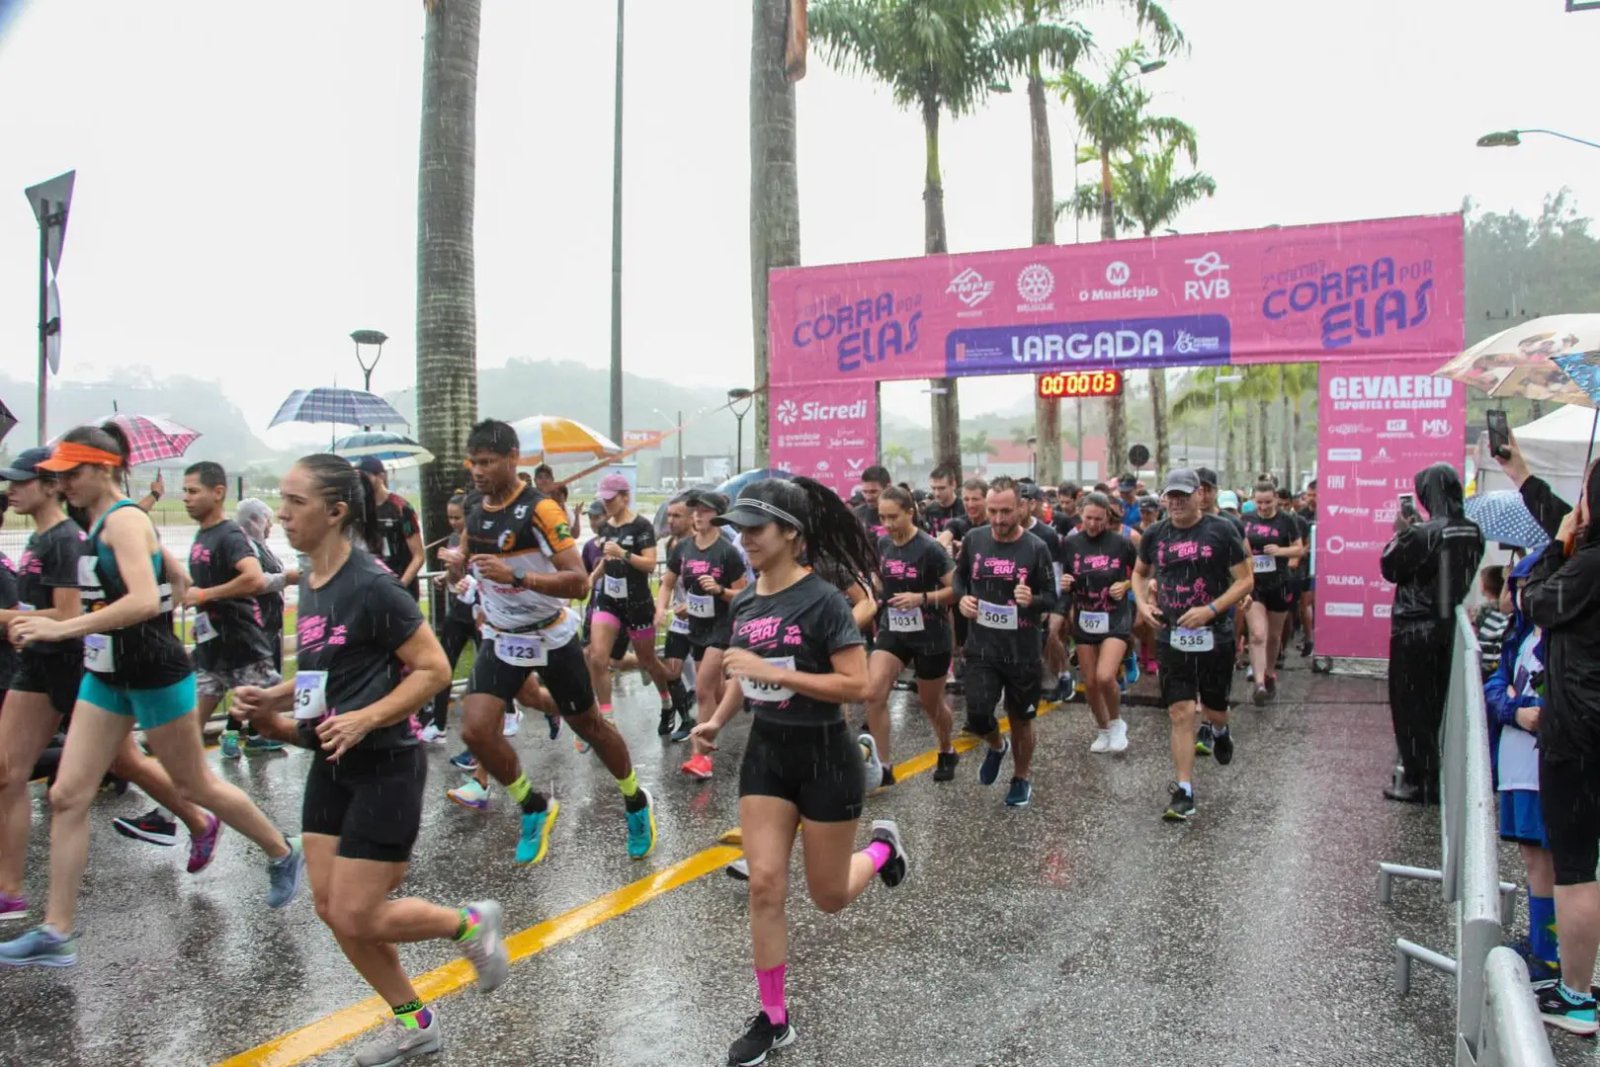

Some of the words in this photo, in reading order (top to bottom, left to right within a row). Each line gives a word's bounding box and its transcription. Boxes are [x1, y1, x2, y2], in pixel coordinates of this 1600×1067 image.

[945, 279, 996, 294] AMPE
[1079, 290, 1088, 301] O
[1184, 278, 1231, 301] RVB
[1262, 256, 1395, 320] CORRA
[1400, 258, 1433, 283] POR
[792, 291, 894, 348] CORRA
[1321, 278, 1434, 350] ELAS
[837, 309, 923, 372] ELAS
[1011, 329, 1164, 362] LARGADA
[1329, 375, 1453, 399] GEVAERD
[801, 399, 868, 421] Sicredi
[892, 616, 918, 627] 1031
[984, 612, 1008, 625] 505
[1180, 635, 1204, 646] 535
[507, 646, 535, 660] 123
